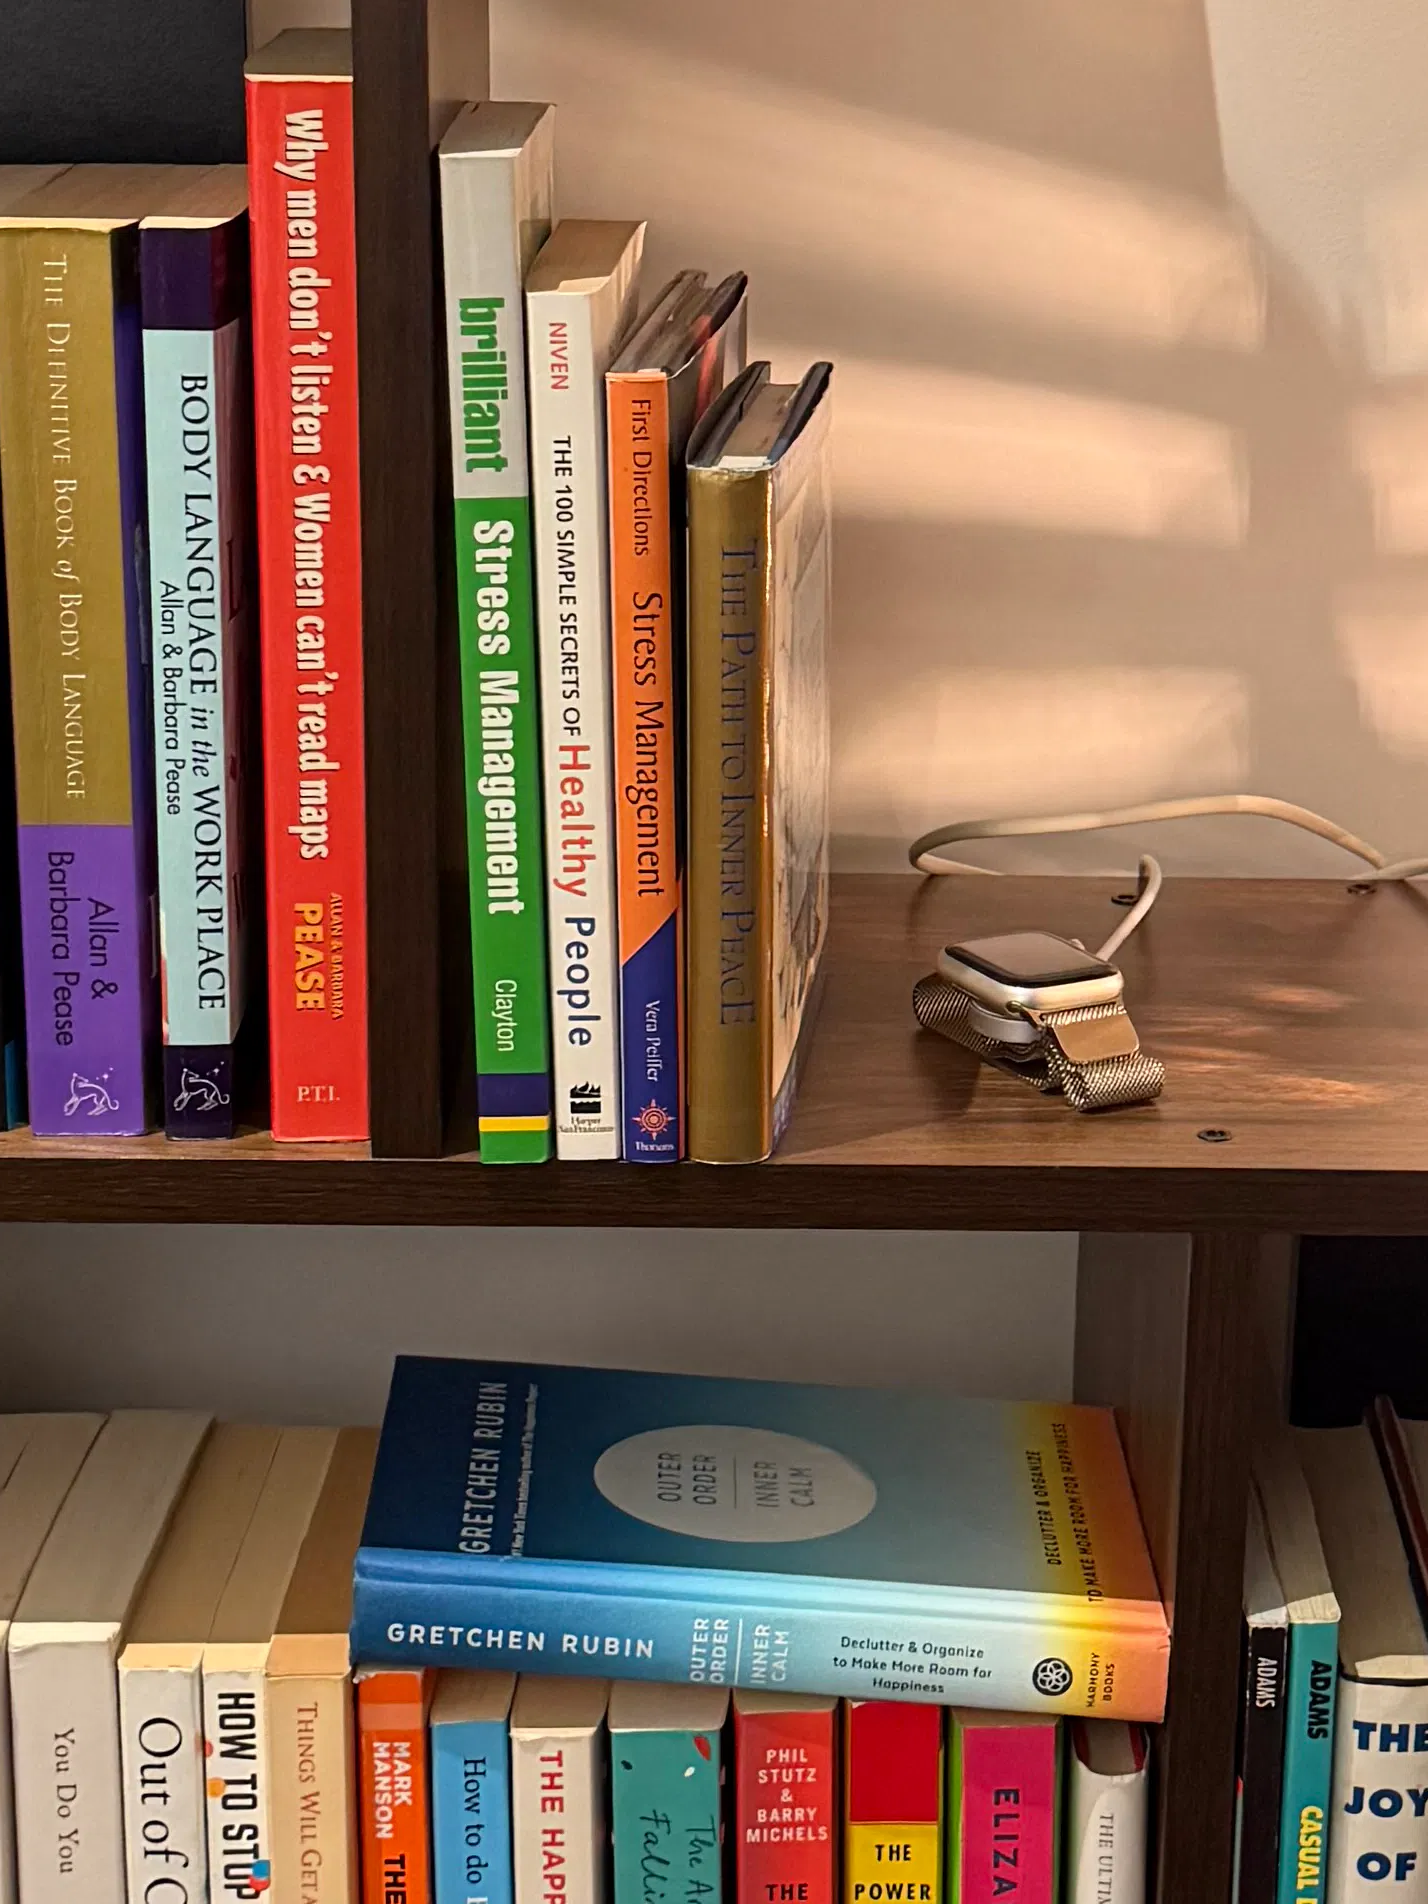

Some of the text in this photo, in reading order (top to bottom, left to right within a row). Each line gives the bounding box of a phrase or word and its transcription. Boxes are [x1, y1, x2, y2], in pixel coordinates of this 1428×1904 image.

[460, 296, 510, 472] brilliant
[547, 322, 570, 389] NIVEN
[275, 109, 335, 859] Why men don't listen & Women can't read maps
[553, 435, 582, 735] THE 100 SIMPLE SECRETS OF
[180, 373, 226, 1009] BODY LANGUAGE in the WORK PLACE
[474, 519, 526, 913] Stress Management
[553, 745, 600, 1046] Healthy People
[491, 979, 519, 1051] Clayton
[387, 1622, 654, 1660] GRETCHEN RUBIN
[689, 1618, 708, 1682] OUTER
[710, 1619, 729, 1685] ORDER
[751, 1624, 770, 1684] INNER
[771, 1630, 788, 1682] CALM
[137, 1717, 183, 1804] Out
[390, 1742, 412, 1804] MARK
[537, 1750, 564, 1814] THE
[758, 1768, 819, 1783] STUTZ
[767, 1748, 810, 1762] PHIL
[372, 1742, 393, 1837] MANSON
[756, 1807, 819, 1823] BARRY
[140, 1819, 189, 1866] of
[746, 1827, 829, 1842] MICHELS
[874, 1844, 912, 1862] THE
[1294, 1807, 1322, 1889] CASUAL
[853, 1882, 932, 1901] POWER
[1358, 1852, 1416, 1882] OF
